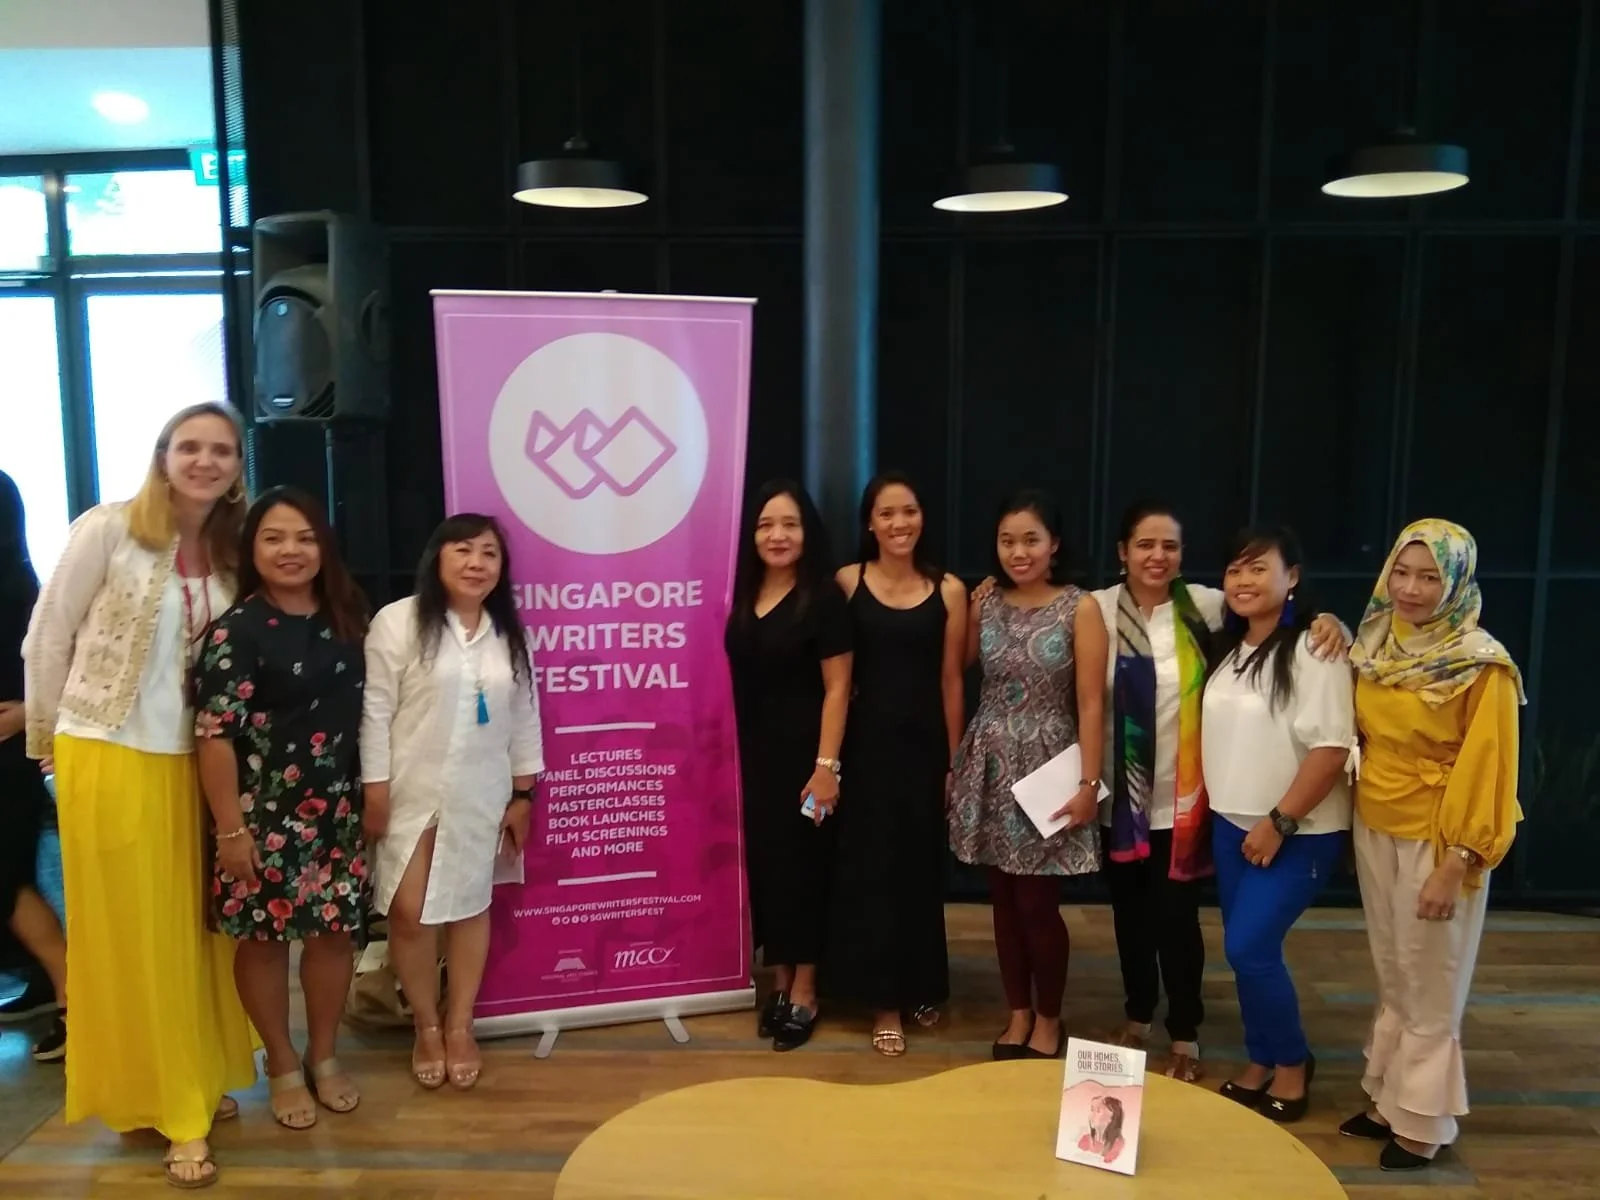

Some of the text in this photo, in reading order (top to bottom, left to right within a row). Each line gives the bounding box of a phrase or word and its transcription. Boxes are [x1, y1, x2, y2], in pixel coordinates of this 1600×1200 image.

[524, 622, 687, 652] WRITERS
[570, 749, 642, 765] LECTURES
[537, 764, 677, 783] PANEL DISCUSSIONS
[550, 780, 664, 798] PERFORMANCES
[548, 795, 666, 814] MASTERCLASSES
[549, 810, 666, 830] BOOK LAUNCHES
[546, 825, 669, 845] FILM SCREENINGS
[571, 841, 645, 859] AND MORE
[513, 894, 702, 918] WWW.SINGAPOREWRITERSFESTIVAL.COM
[1077, 1050, 1093, 1060] OUR
[1077, 1060, 1123, 1073] OUR STORIES
